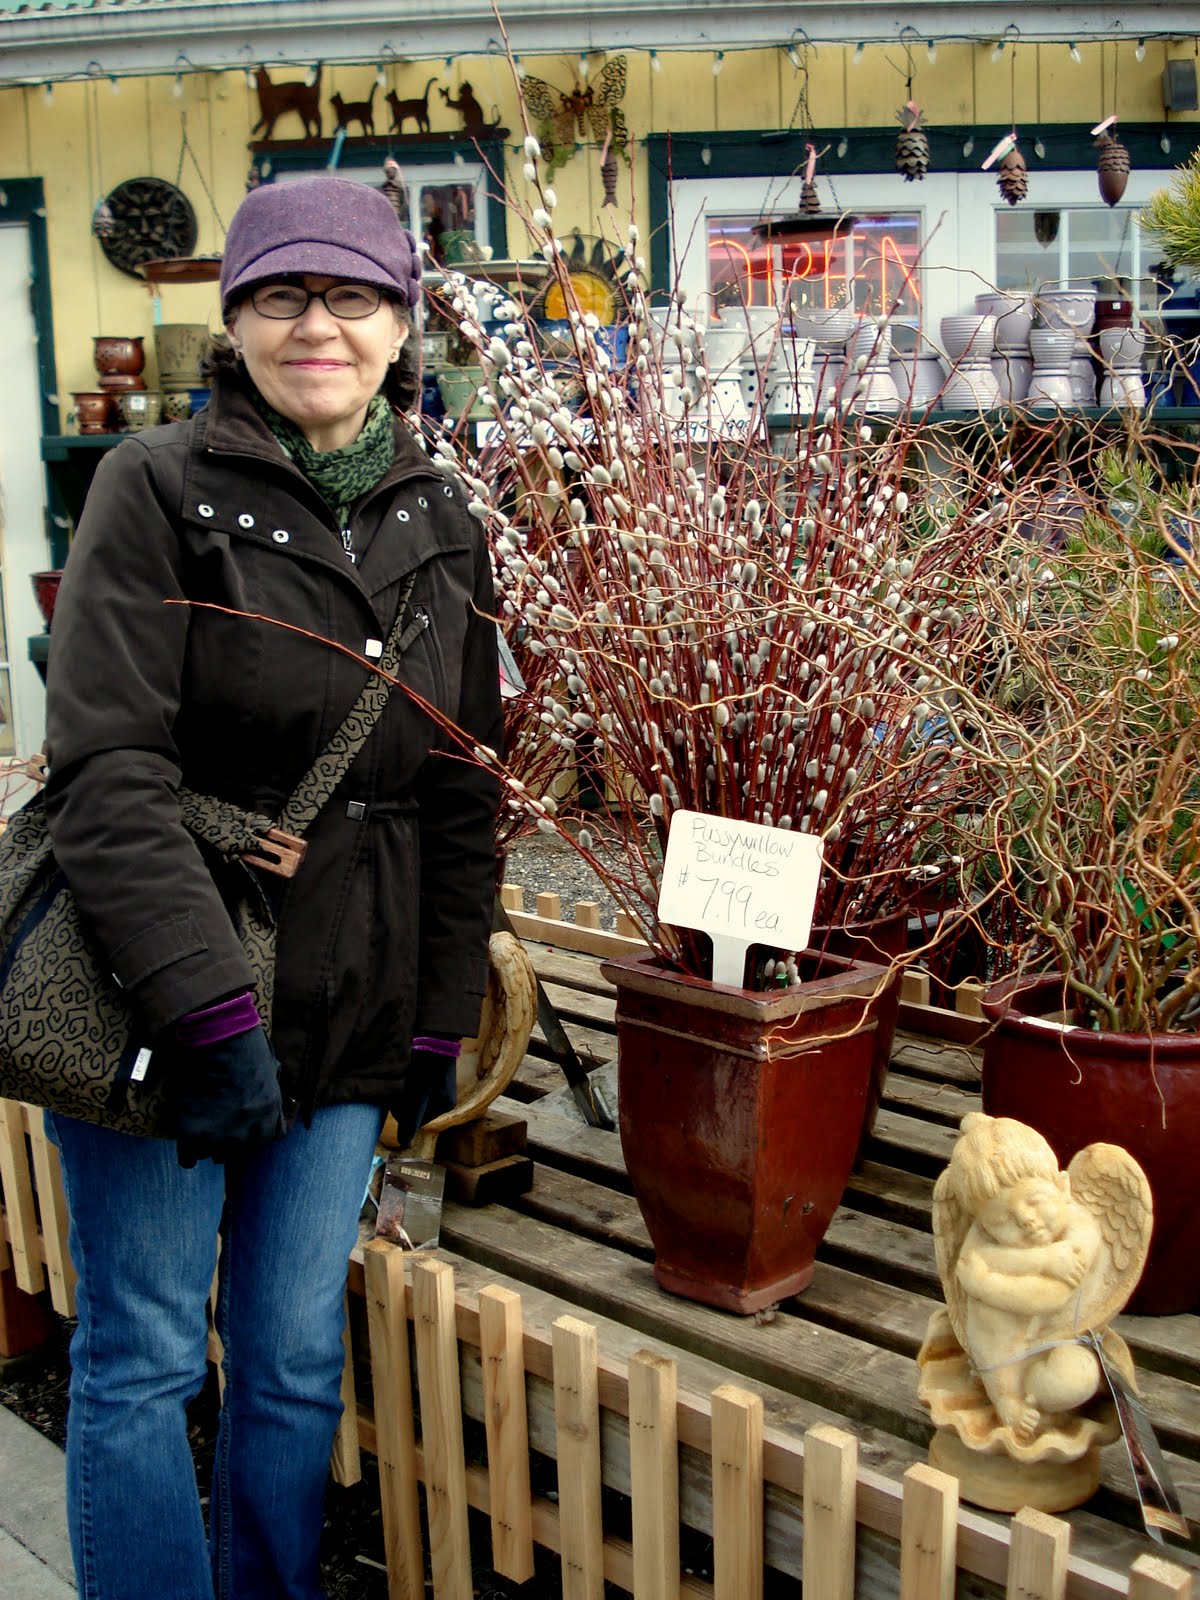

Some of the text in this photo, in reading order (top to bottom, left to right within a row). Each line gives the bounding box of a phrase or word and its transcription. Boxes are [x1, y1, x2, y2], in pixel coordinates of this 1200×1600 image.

[708, 235, 920, 320] OPEN
[692, 817, 794, 858] Pussywillow
[695, 841, 780, 877] Bundles
